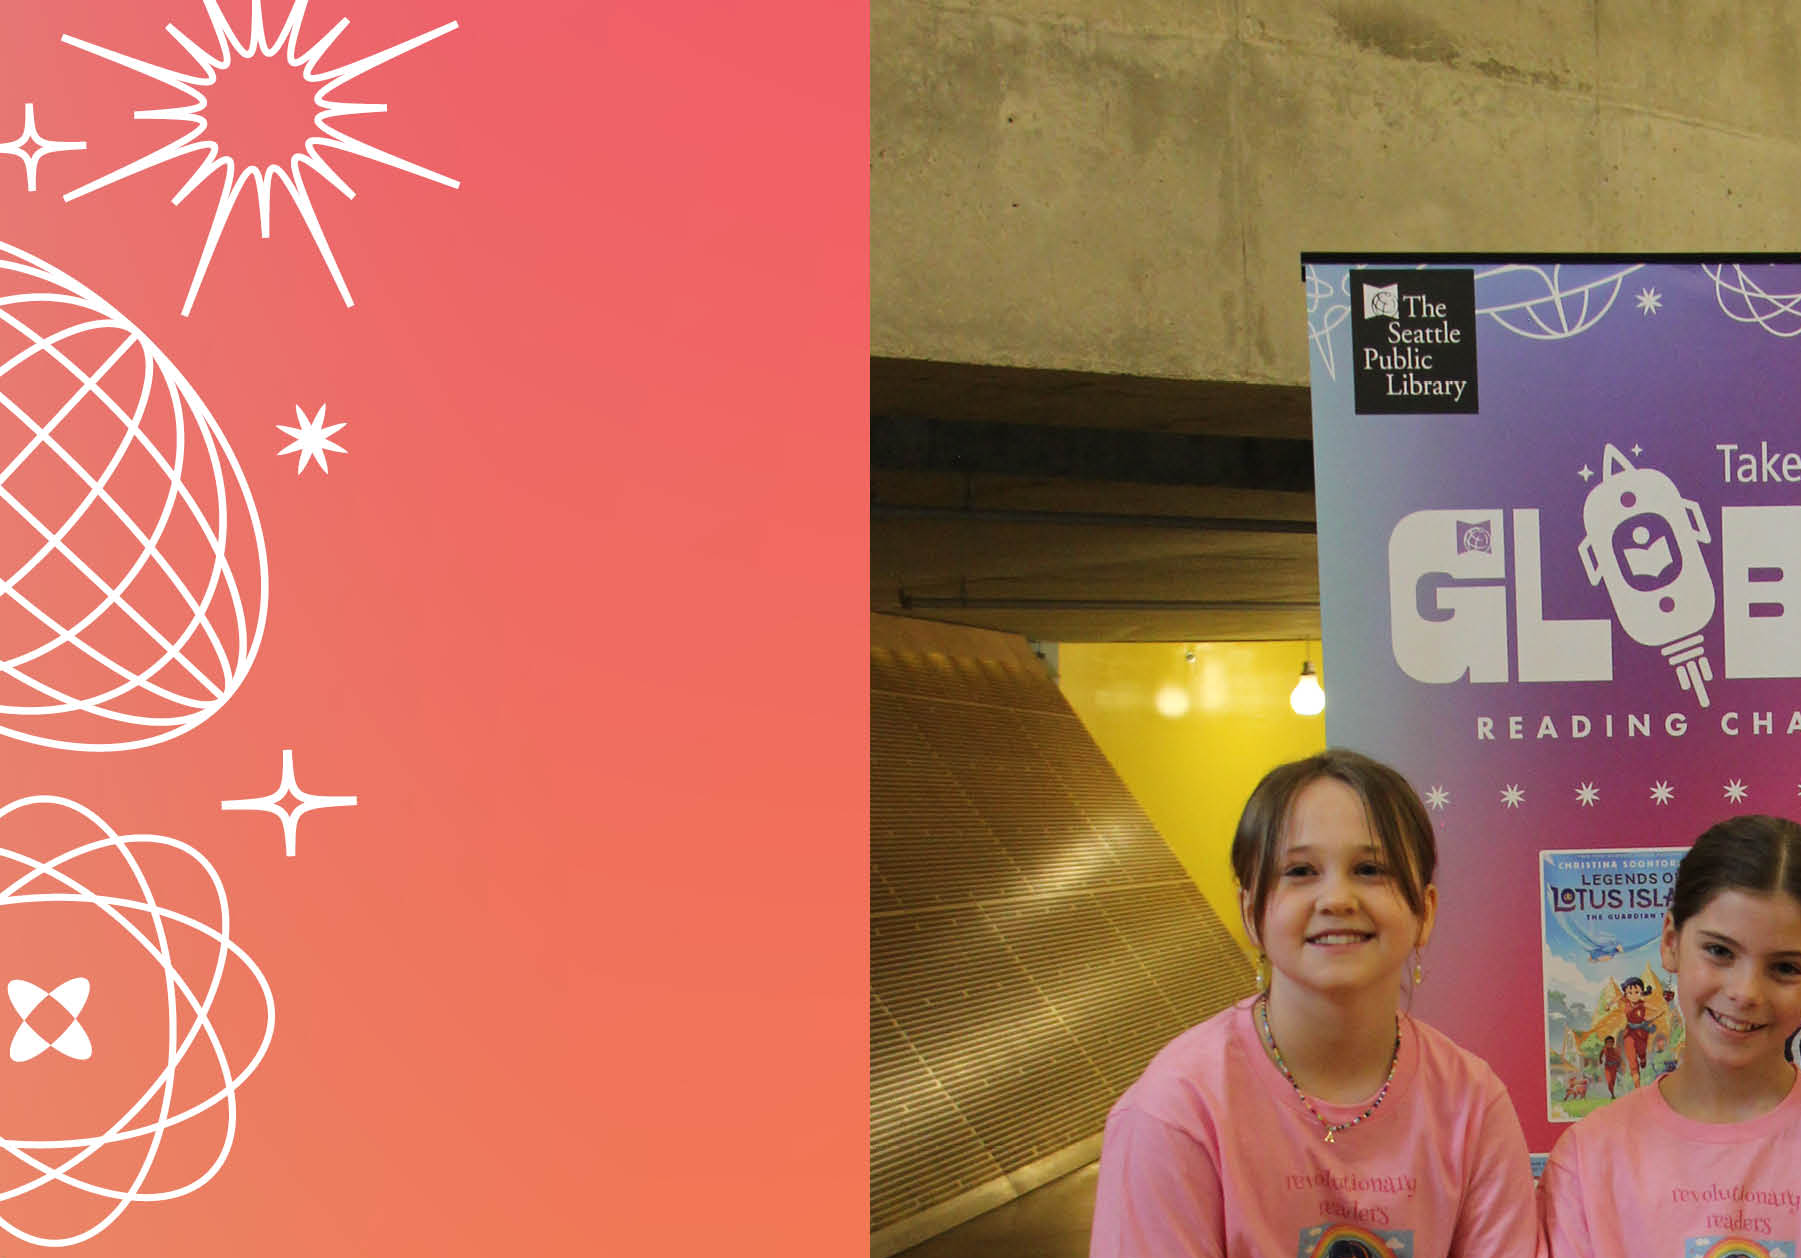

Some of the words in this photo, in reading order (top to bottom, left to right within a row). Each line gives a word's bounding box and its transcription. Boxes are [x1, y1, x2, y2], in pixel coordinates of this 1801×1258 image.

[1402, 294, 1447, 318] The
[1387, 320, 1461, 344] Seattle
[1363, 346, 1433, 370] Public
[1386, 372, 1467, 402] Library
[1716, 443, 1801, 483] Take
[1477, 713, 1690, 742] READING
[1582, 873, 1658, 886] LEGENDS
[1551, 886, 1623, 912] LOTUS
[1671, 1183, 1800, 1215] revolutionary
[1705, 1208, 1771, 1234] readers
